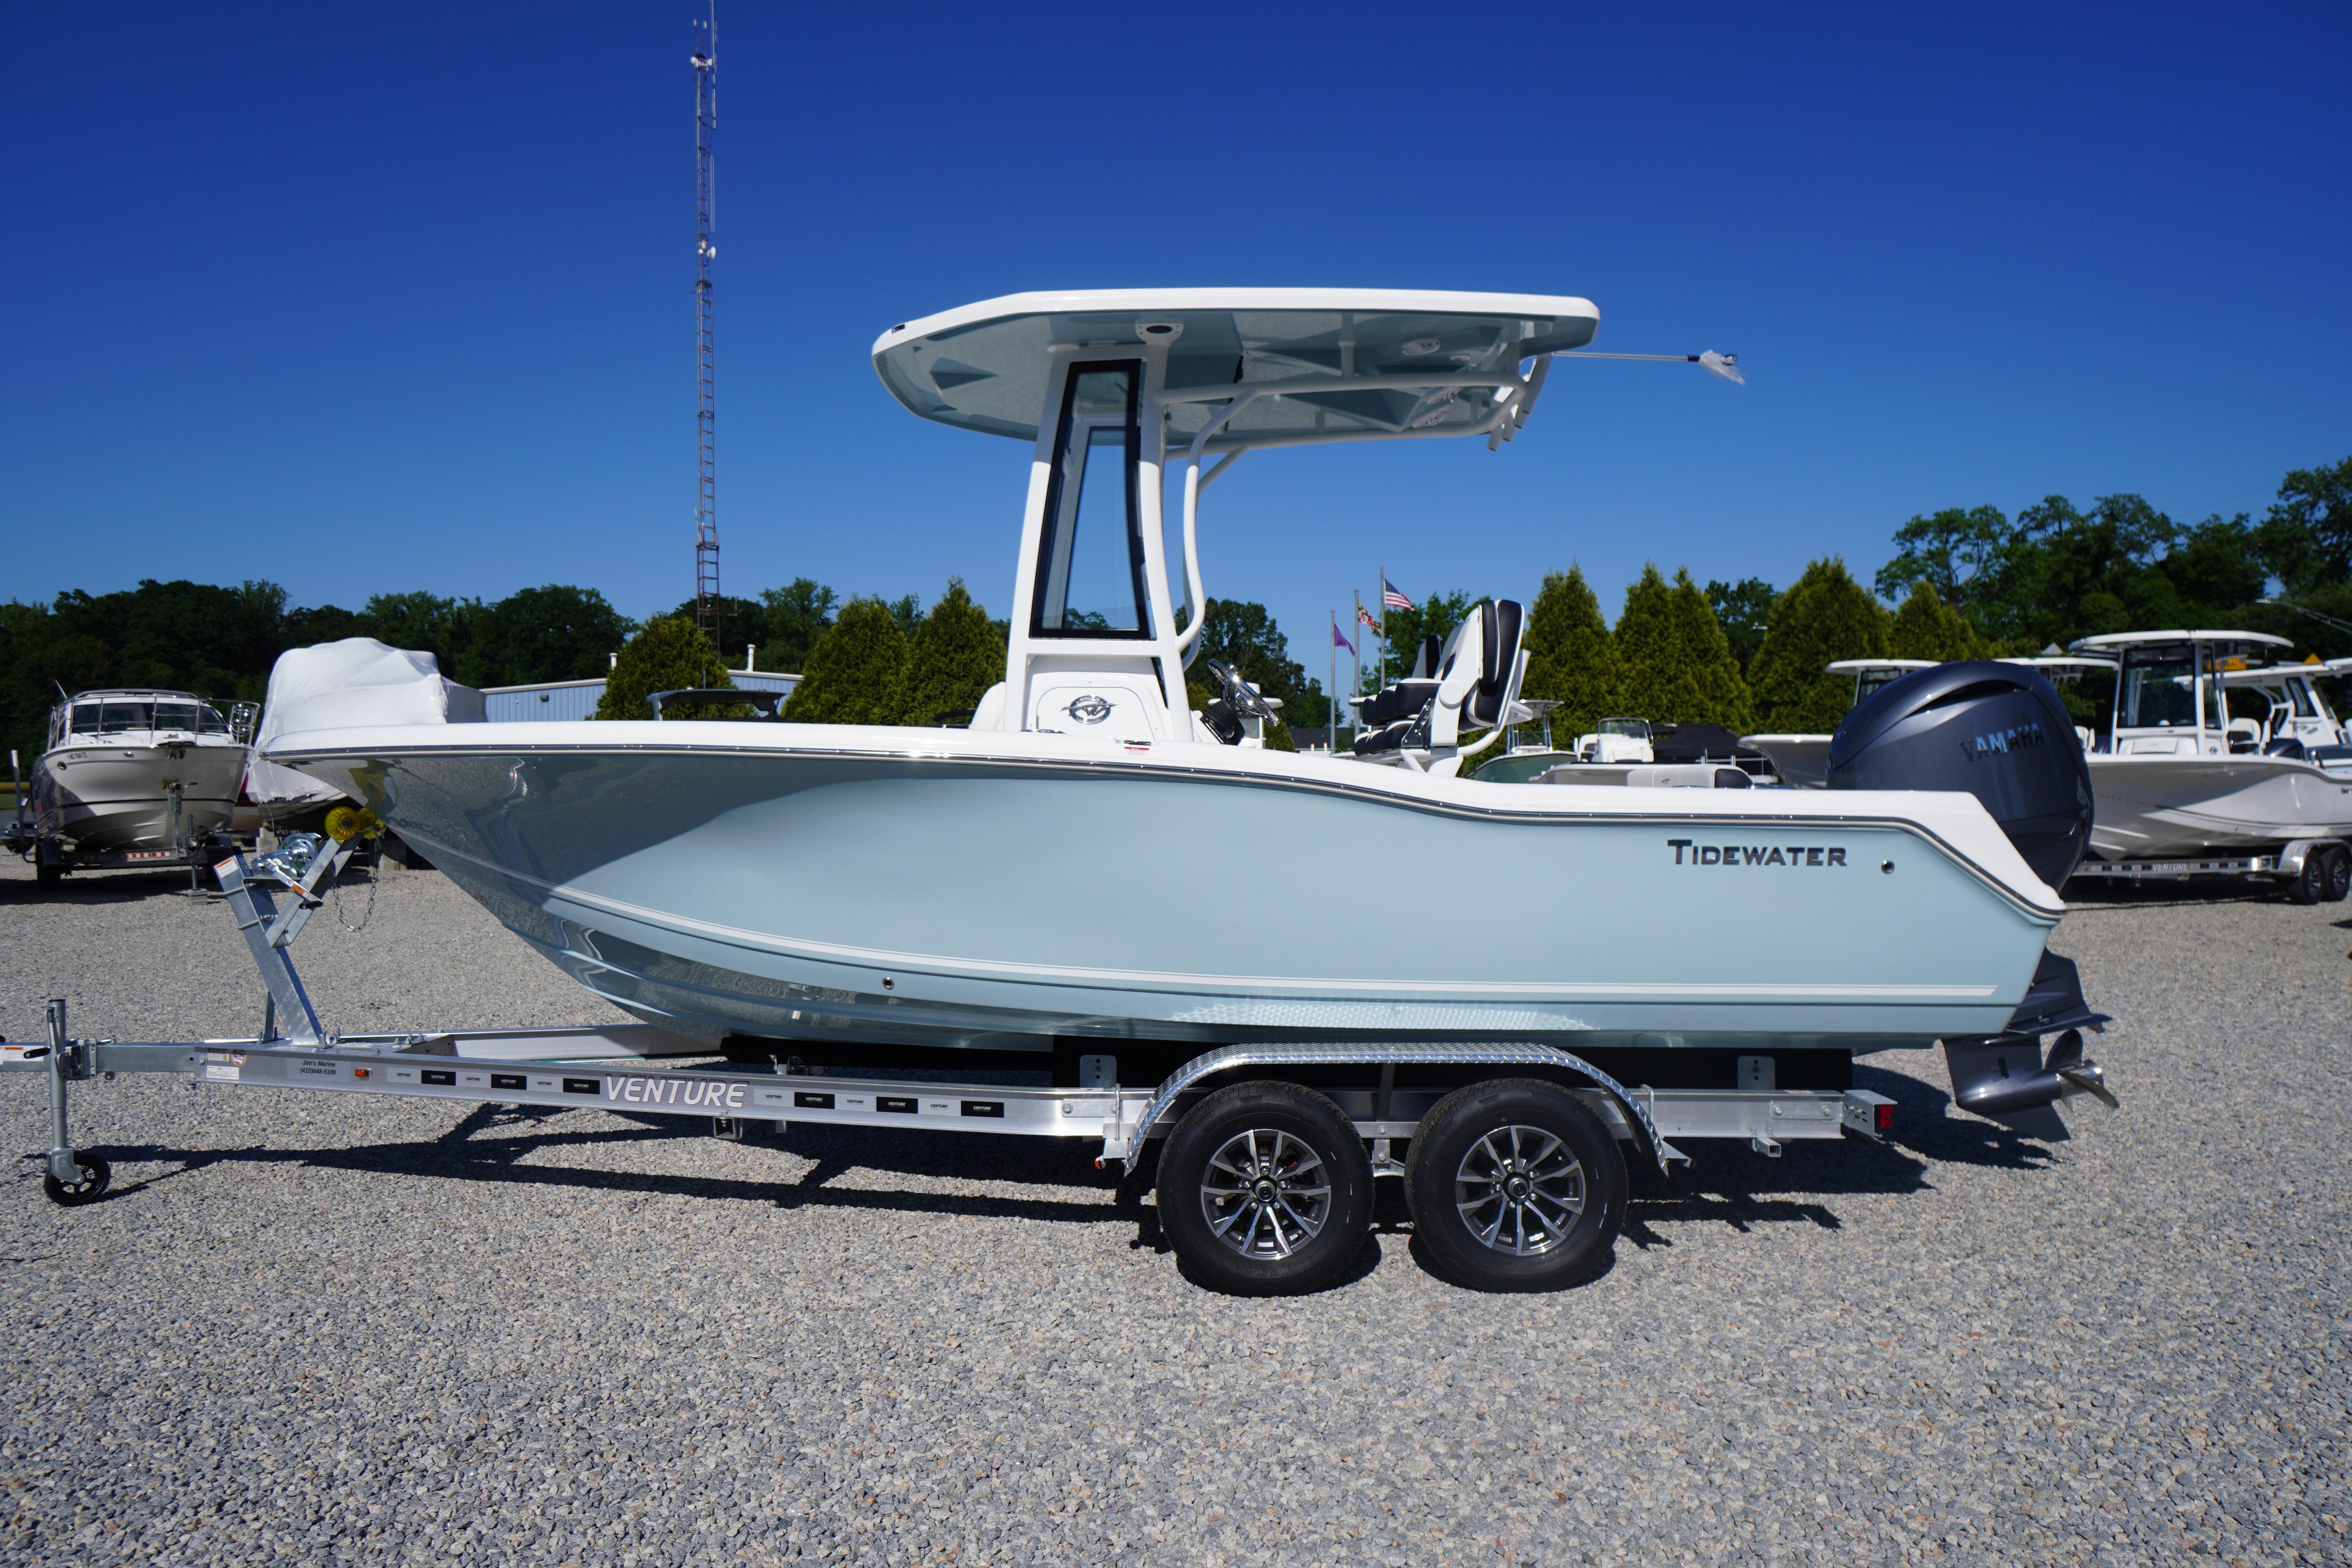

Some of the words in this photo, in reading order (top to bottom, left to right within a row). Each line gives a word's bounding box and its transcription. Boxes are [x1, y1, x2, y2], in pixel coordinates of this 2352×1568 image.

[1960, 723, 2044, 762] YAMAHA
[1667, 839, 1847, 866] TIDEWATER
[2153, 863, 2189, 871] VENTURE
[606, 1074, 750, 1108] VENTURE
